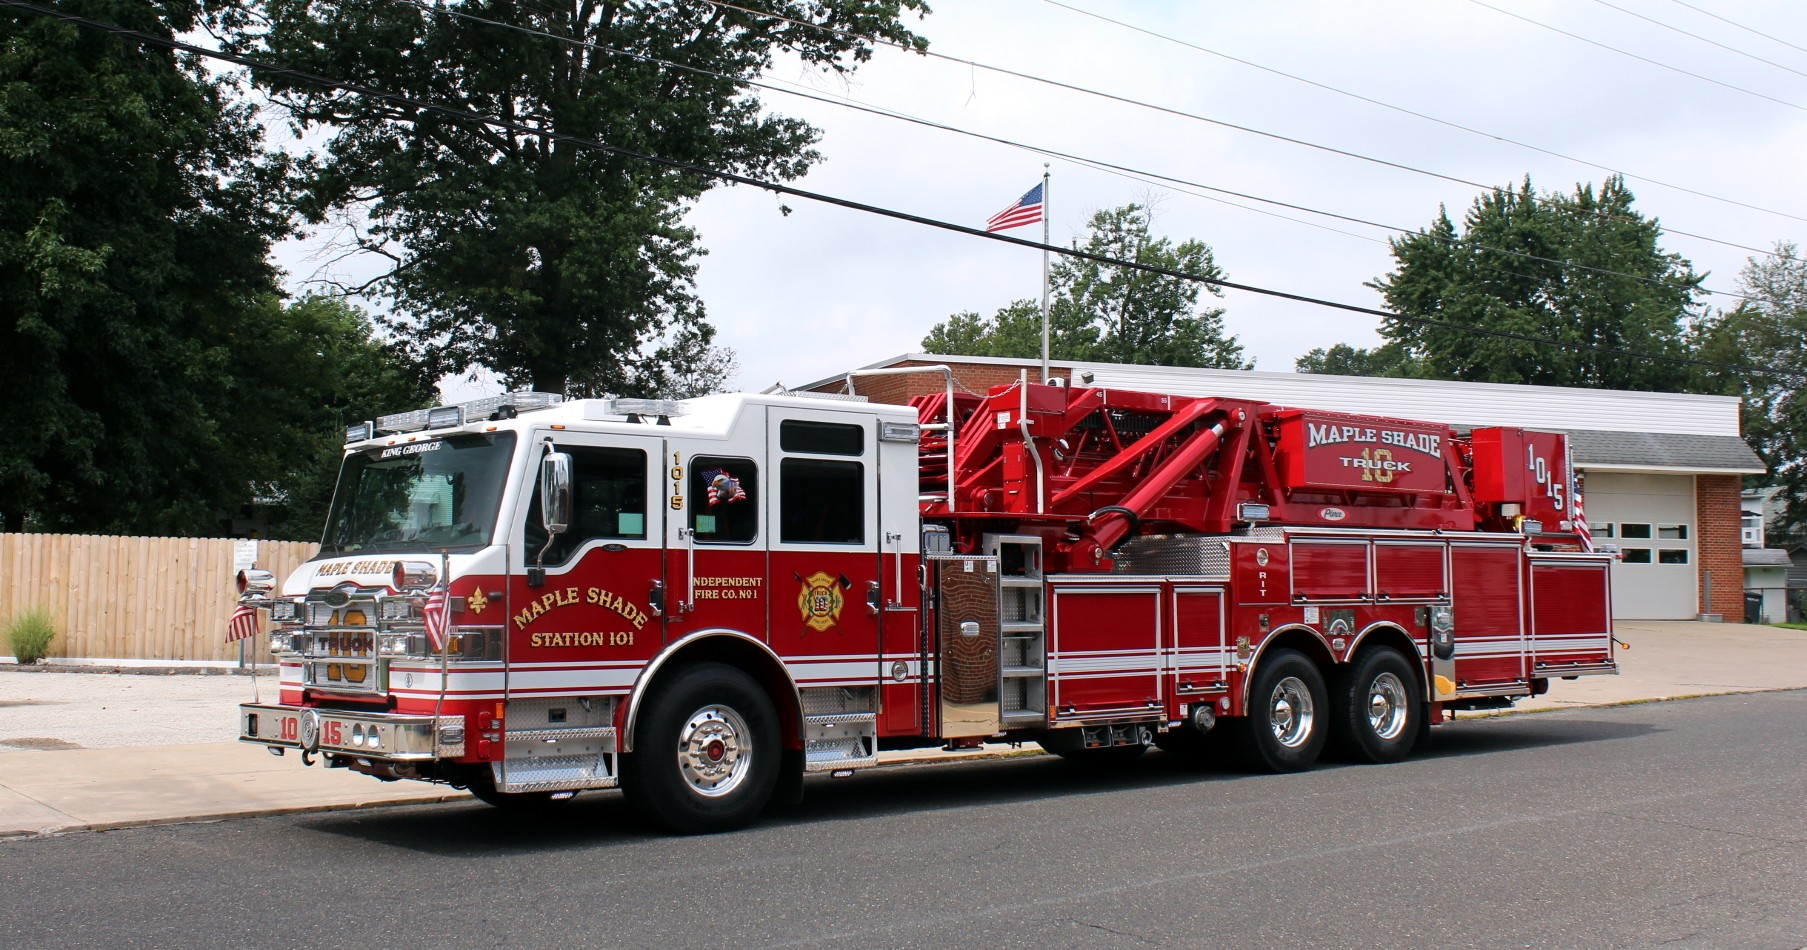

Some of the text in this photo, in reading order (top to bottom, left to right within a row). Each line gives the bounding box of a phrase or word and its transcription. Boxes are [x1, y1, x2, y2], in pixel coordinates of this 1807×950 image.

[380, 441, 442, 459] KING GEORGE
[1308, 423, 1441, 459] MAPLE SHADE
[1339, 456, 1412, 472] TRUCK
[1361, 447, 1394, 483] 10
[1528, 443, 1564, 510] 1015
[671, 451, 684, 511] 1015
[315, 560, 396, 577] MAPLE SHADE
[693, 576, 763, 587] NDEPENDENT
[694, 589, 720, 600] FIRE
[721, 589, 738, 599] CO.
[1259, 571, 1267, 597] RIT
[513, 587, 649, 631] MAPLE SHADE
[531, 631, 634, 647] STATION 101
[280, 716, 342, 745] 10 15
